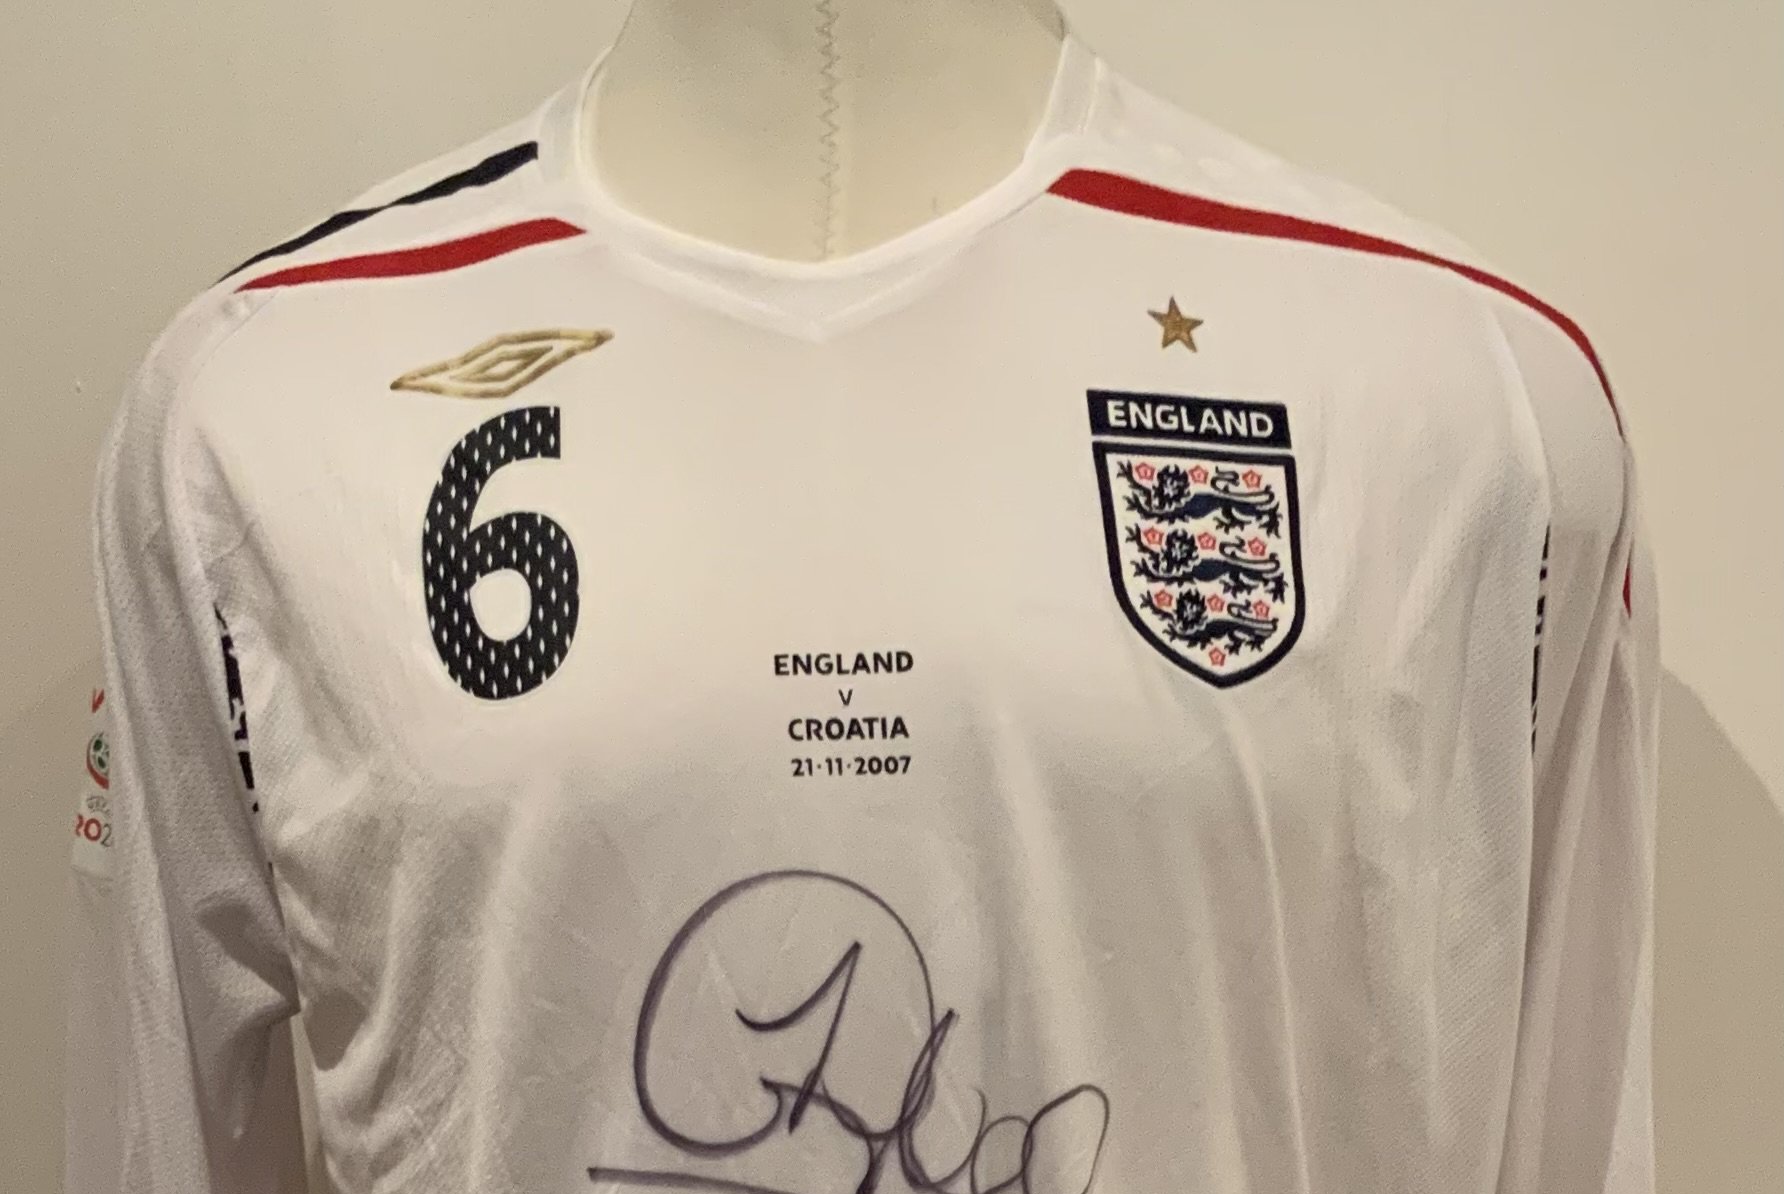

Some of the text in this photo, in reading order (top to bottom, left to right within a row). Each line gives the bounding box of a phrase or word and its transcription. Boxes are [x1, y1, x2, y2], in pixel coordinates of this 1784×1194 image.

[1106, 400, 1274, 438] ENGLAND
[422, 406, 579, 700] 6
[773, 651, 914, 676] ENGLAND
[788, 716, 910, 741] CROATIA
